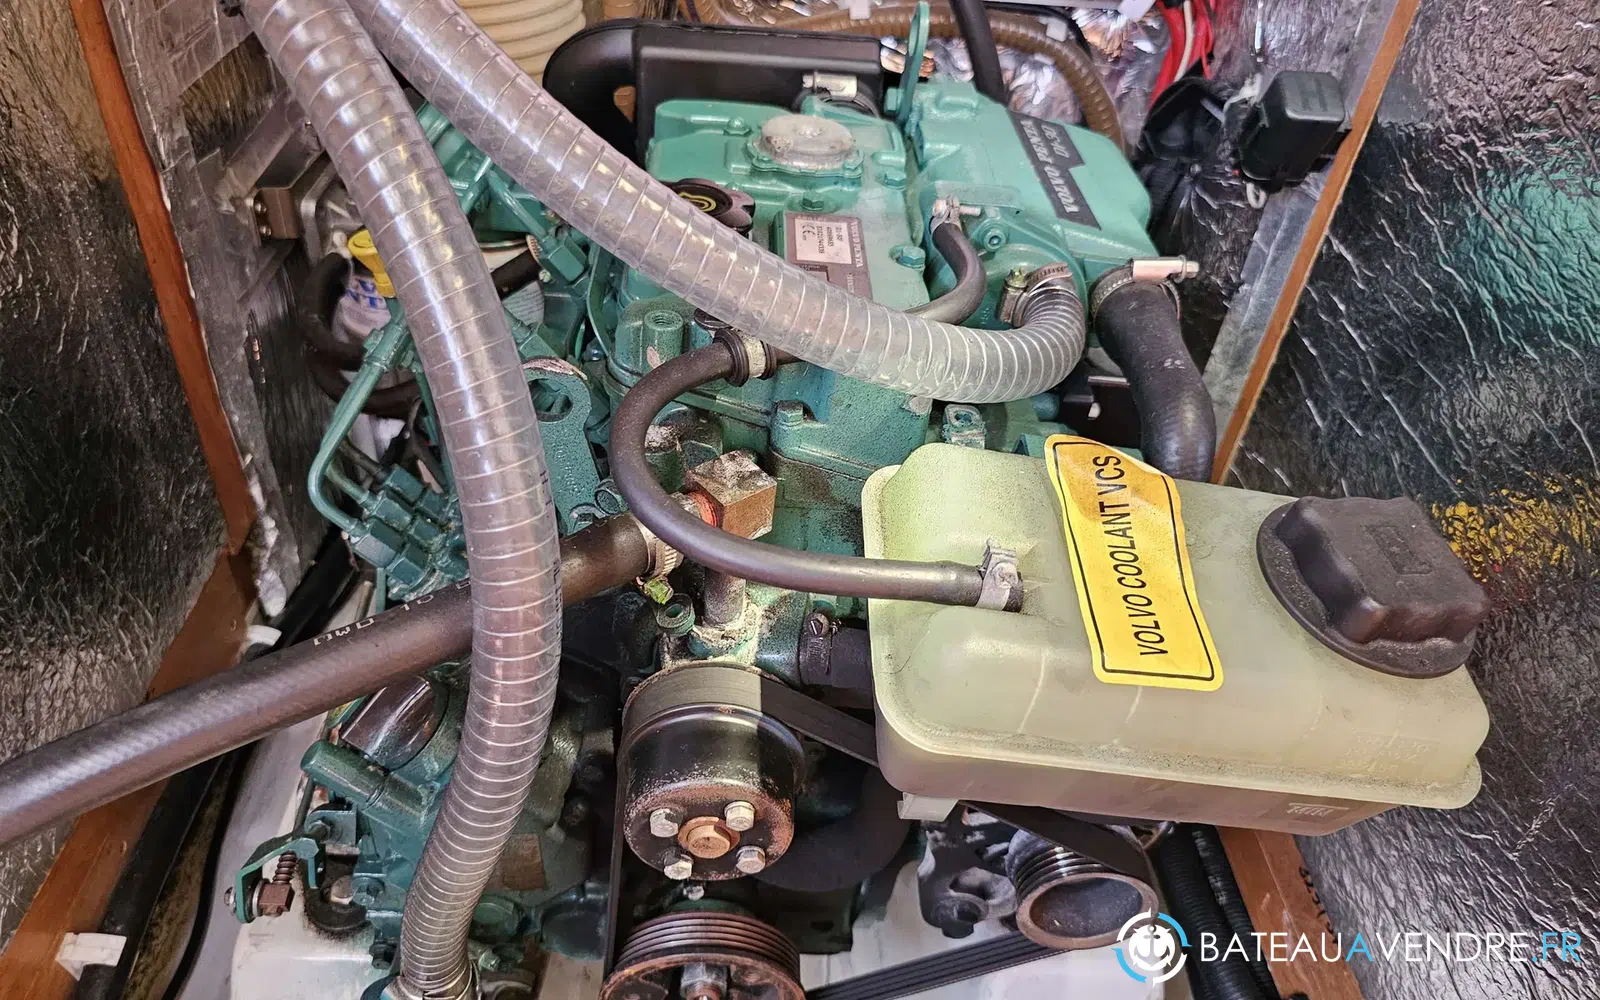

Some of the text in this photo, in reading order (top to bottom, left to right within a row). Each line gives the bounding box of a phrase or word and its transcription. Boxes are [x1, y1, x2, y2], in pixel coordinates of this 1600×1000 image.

[1020, 120, 1079, 213] VOLVO PENTA
[1092, 455, 1168, 656] VOLVO COOLANT VCS
